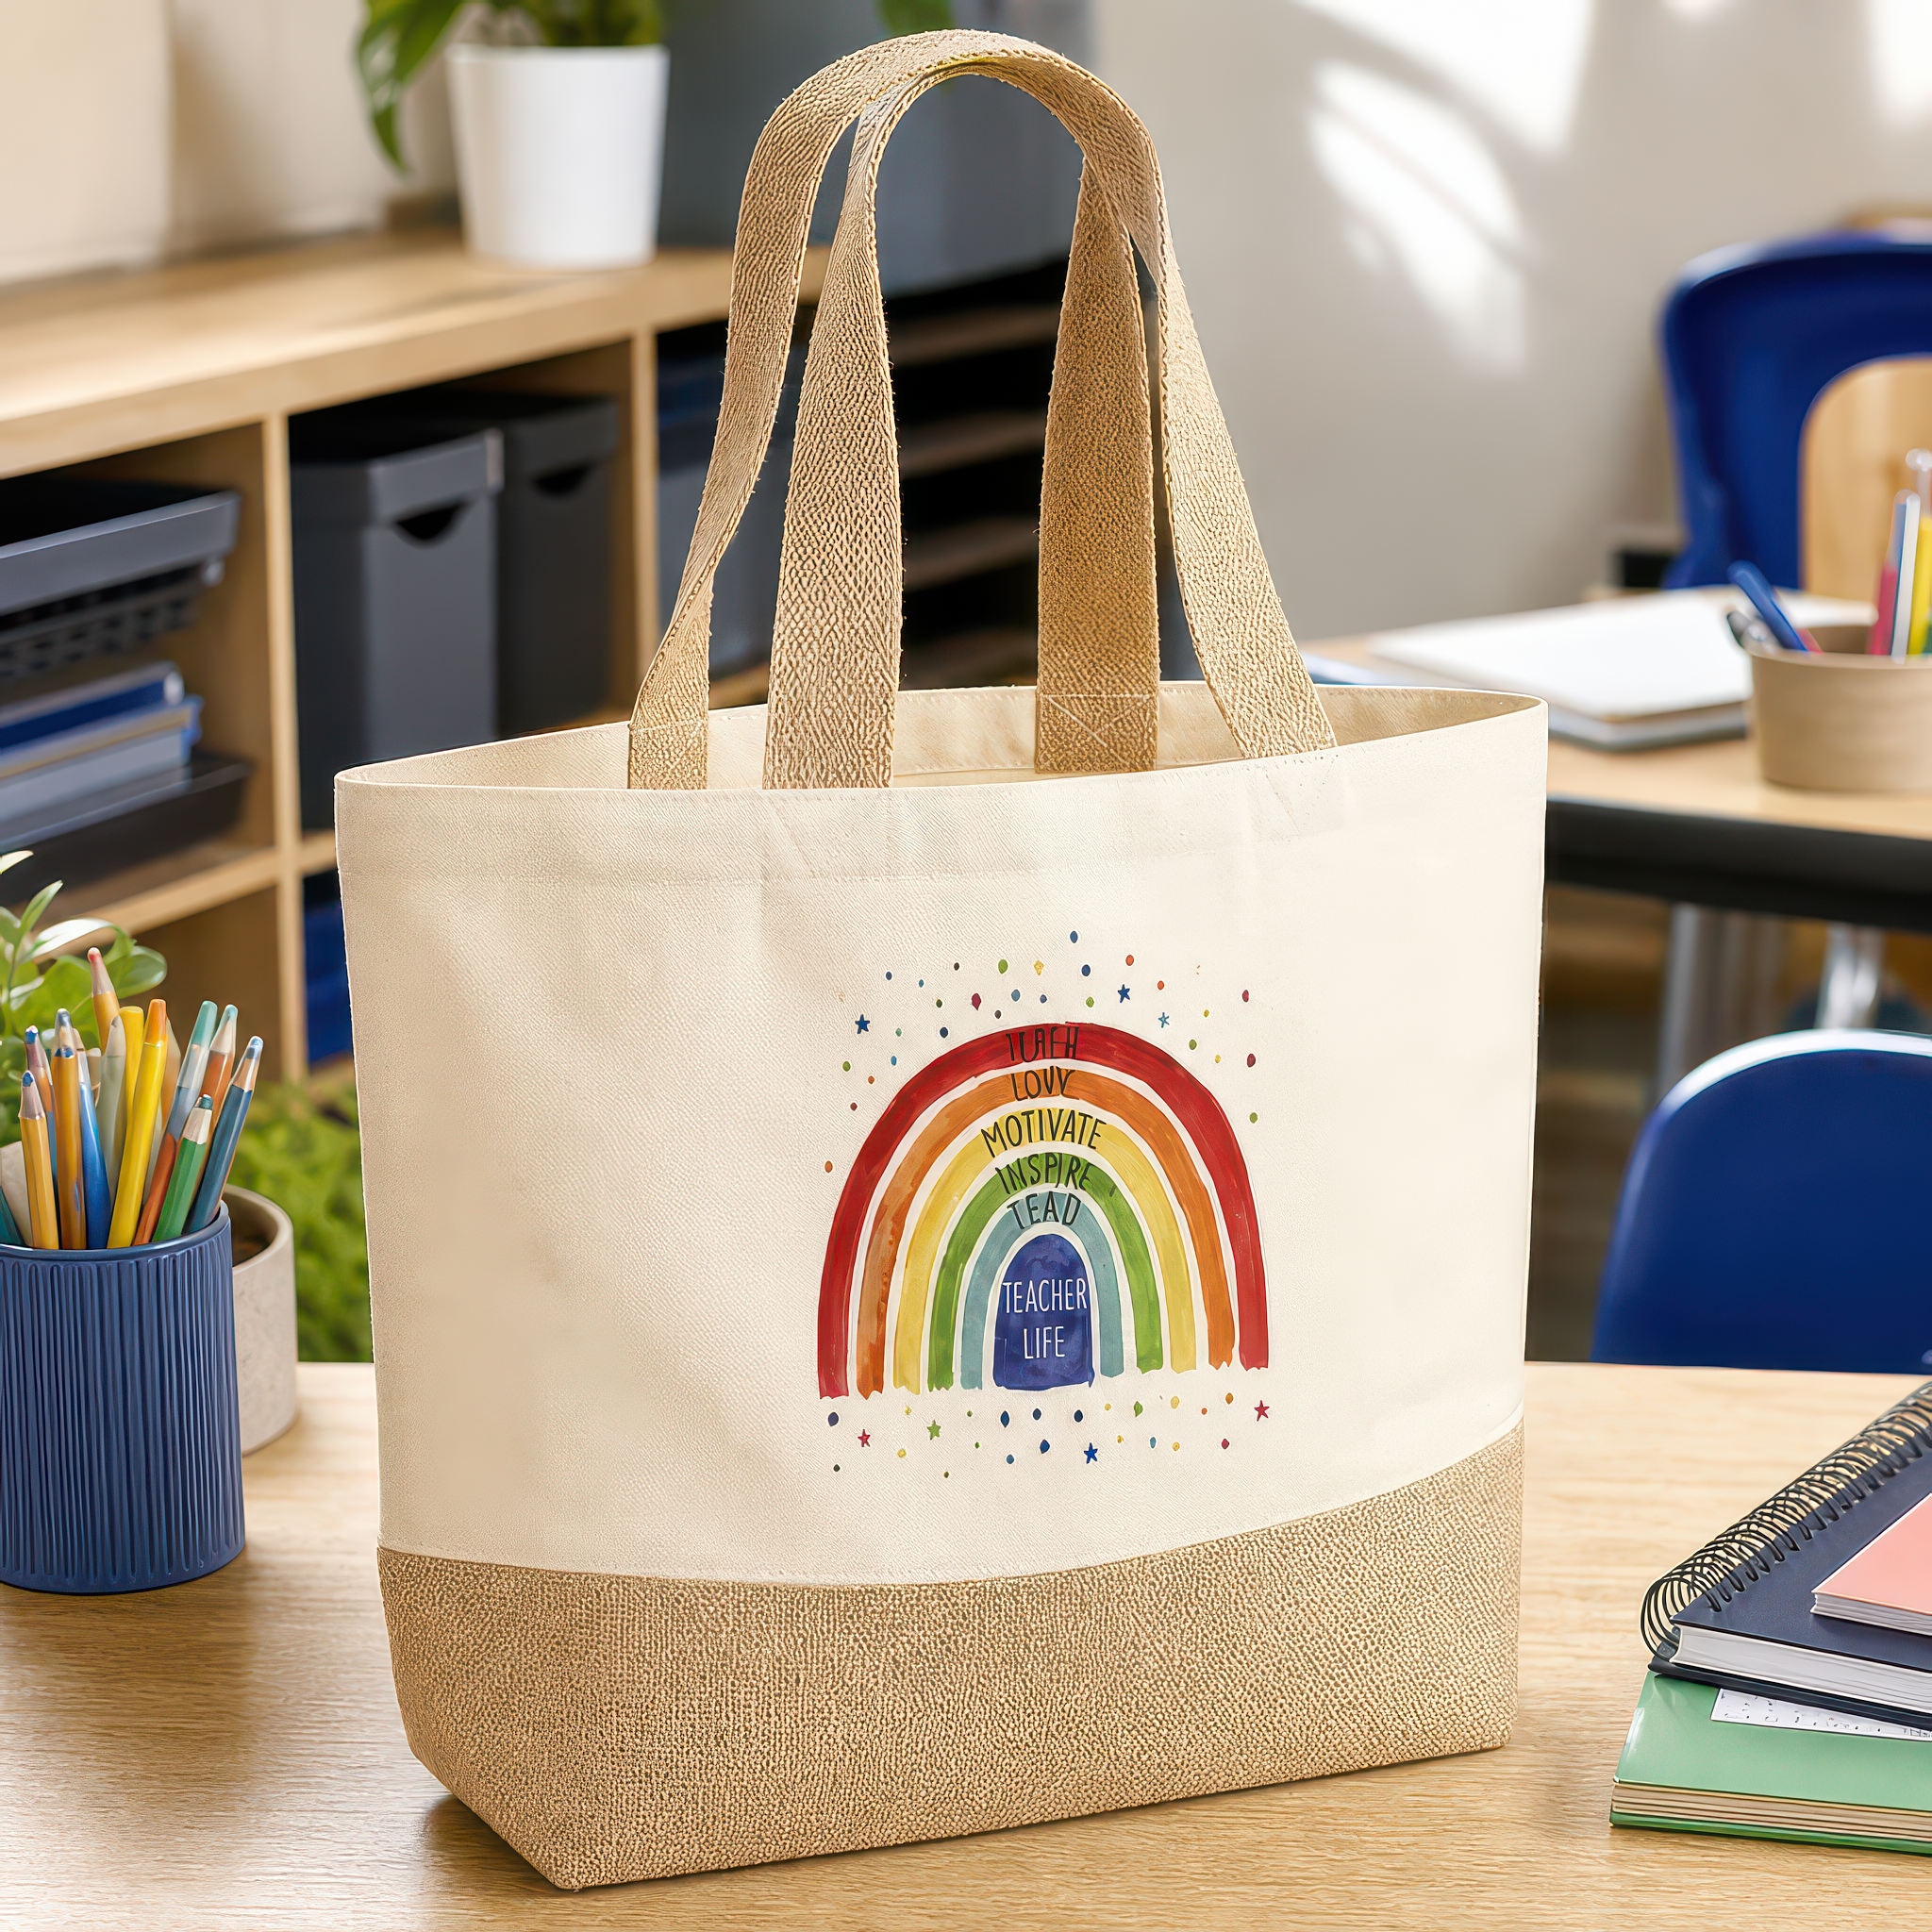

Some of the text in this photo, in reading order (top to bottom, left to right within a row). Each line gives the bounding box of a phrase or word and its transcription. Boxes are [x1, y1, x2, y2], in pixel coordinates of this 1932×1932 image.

[980, 1108, 1107, 1158] MOTIVATE
[994, 1152, 1095, 1195] INSPIRE
[1002, 1277, 1088, 1314] TEACHER
[1023, 1325, 1066, 1359] LIFE
